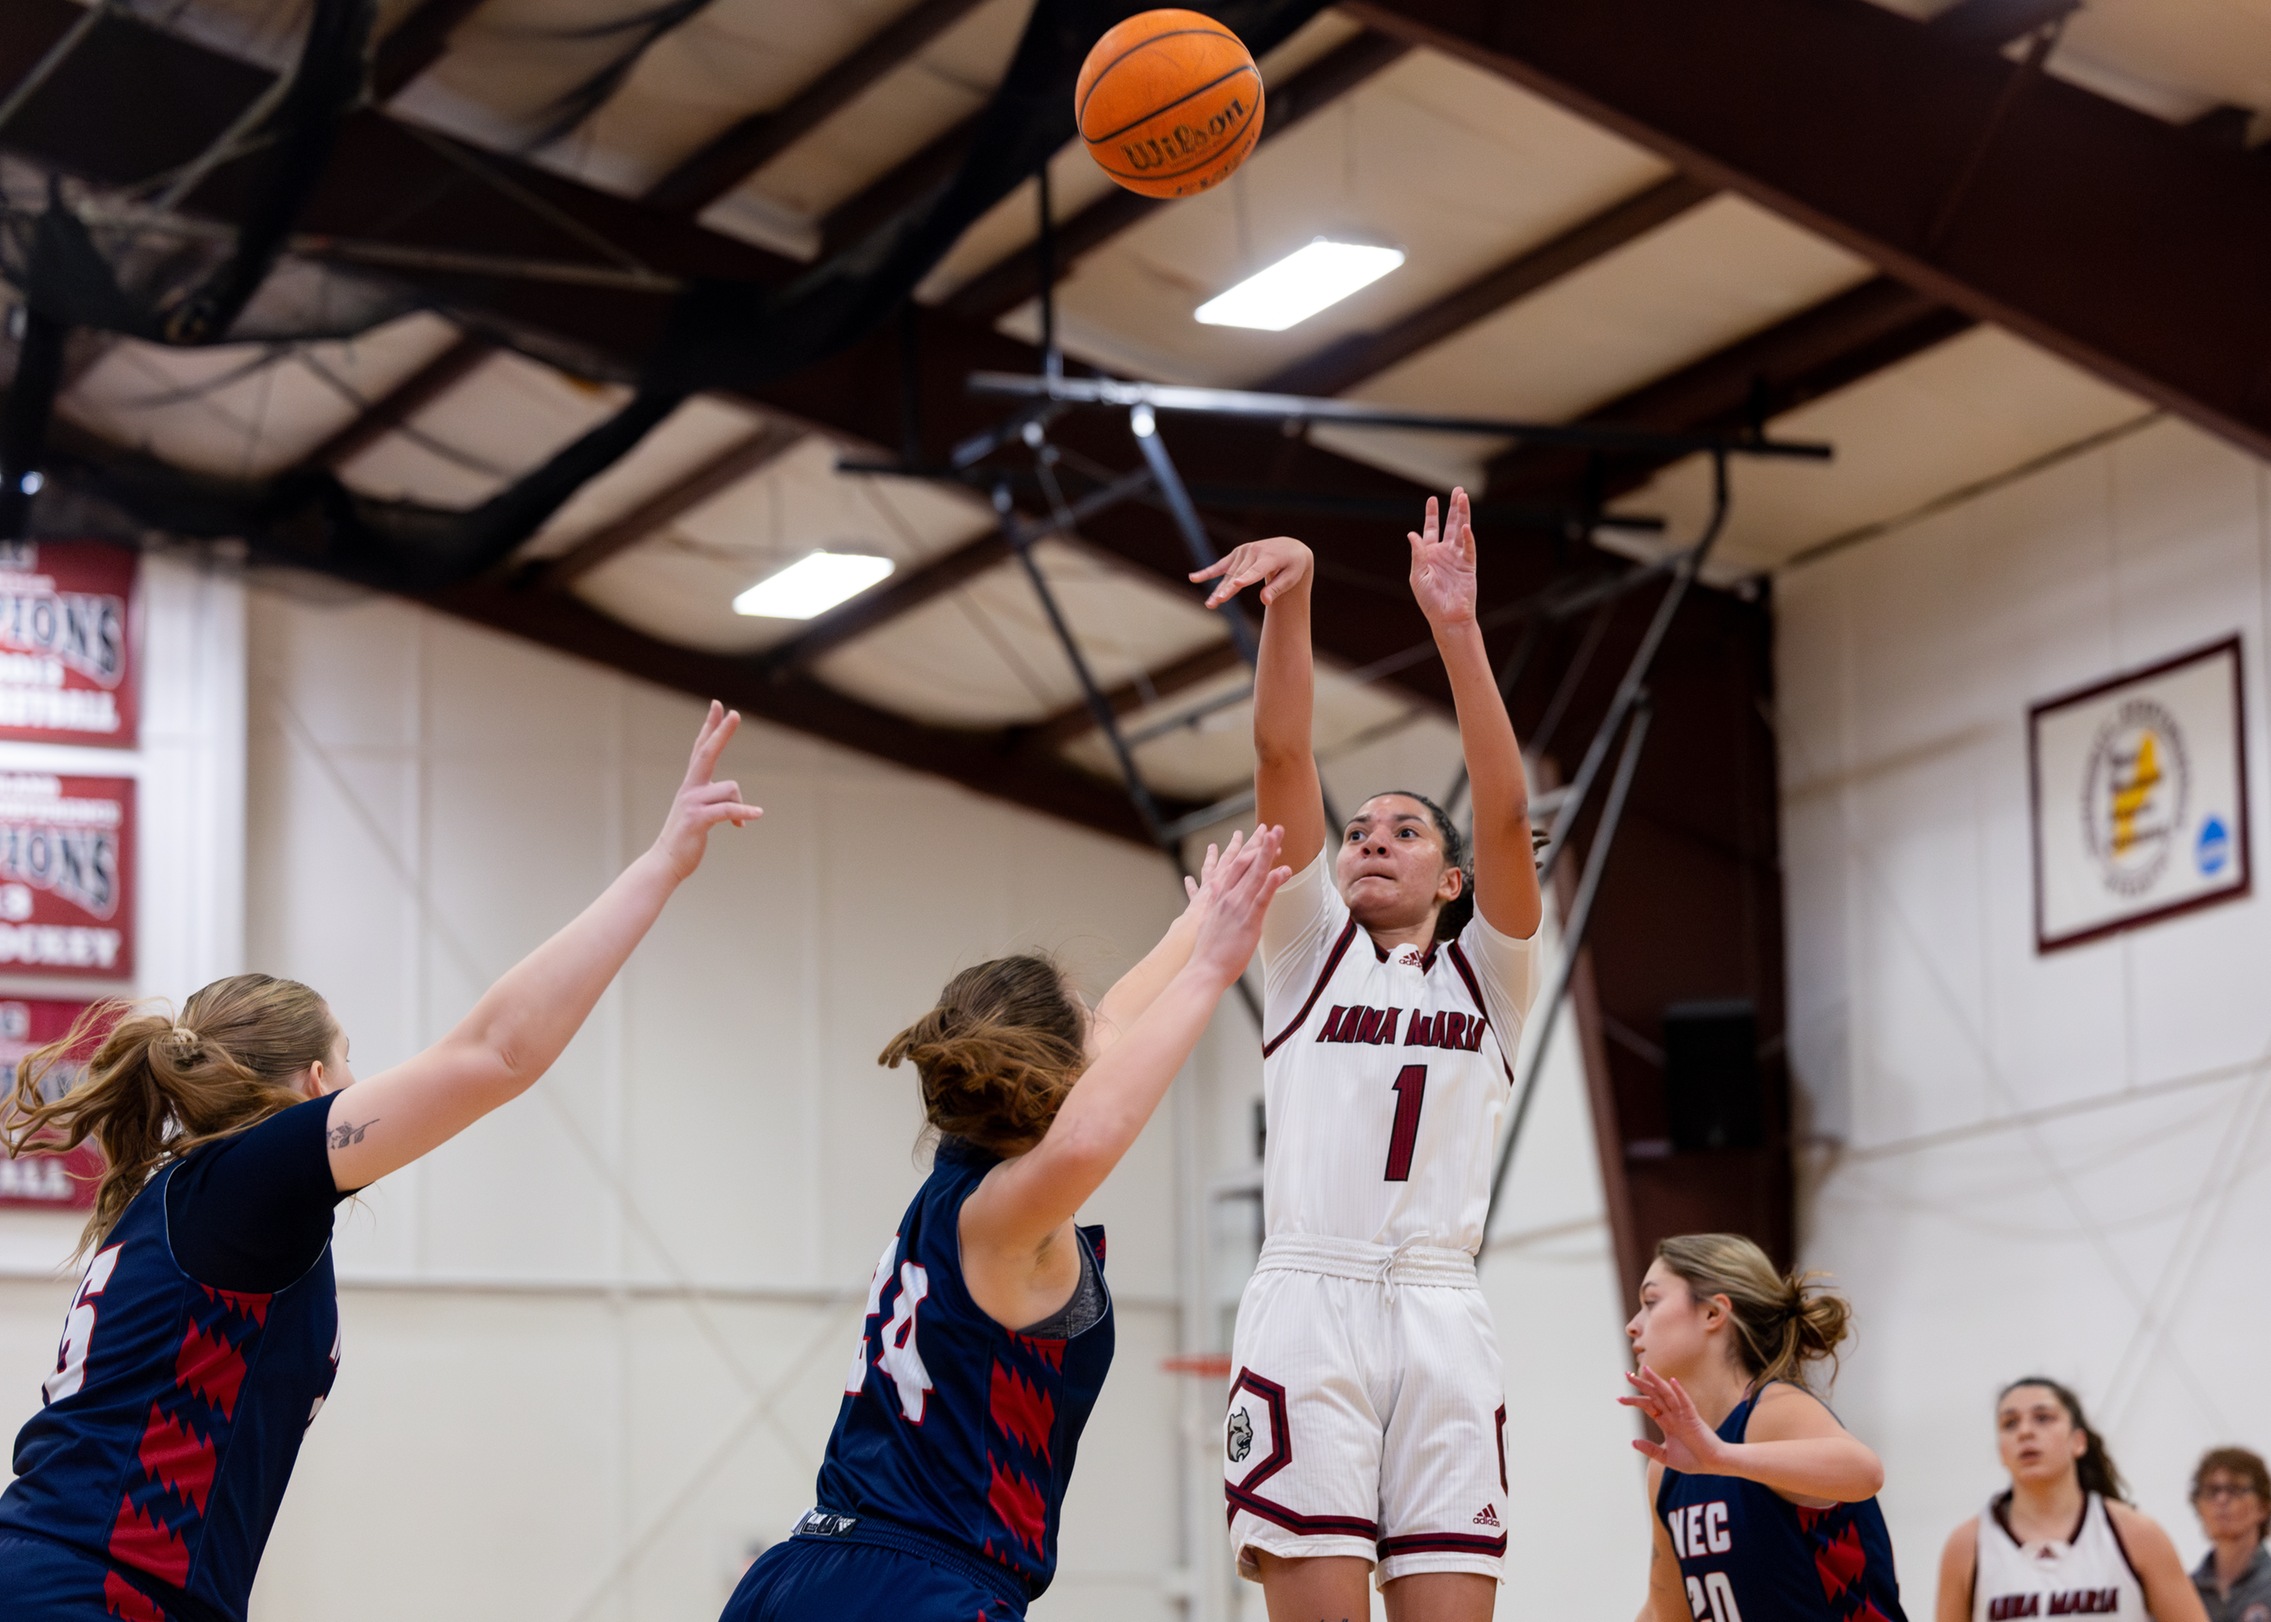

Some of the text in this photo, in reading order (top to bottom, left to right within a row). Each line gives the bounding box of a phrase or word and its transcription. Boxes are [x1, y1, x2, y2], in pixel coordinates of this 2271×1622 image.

[1120, 98, 1245, 171] Wilson
[0, 594, 122, 684] IONS
[0, 828, 118, 912] IONS
[1315, 1004, 1403, 1045] ANNA
[1384, 1064, 1428, 1181] 1
[1473, 1516, 1500, 1528] adidas
